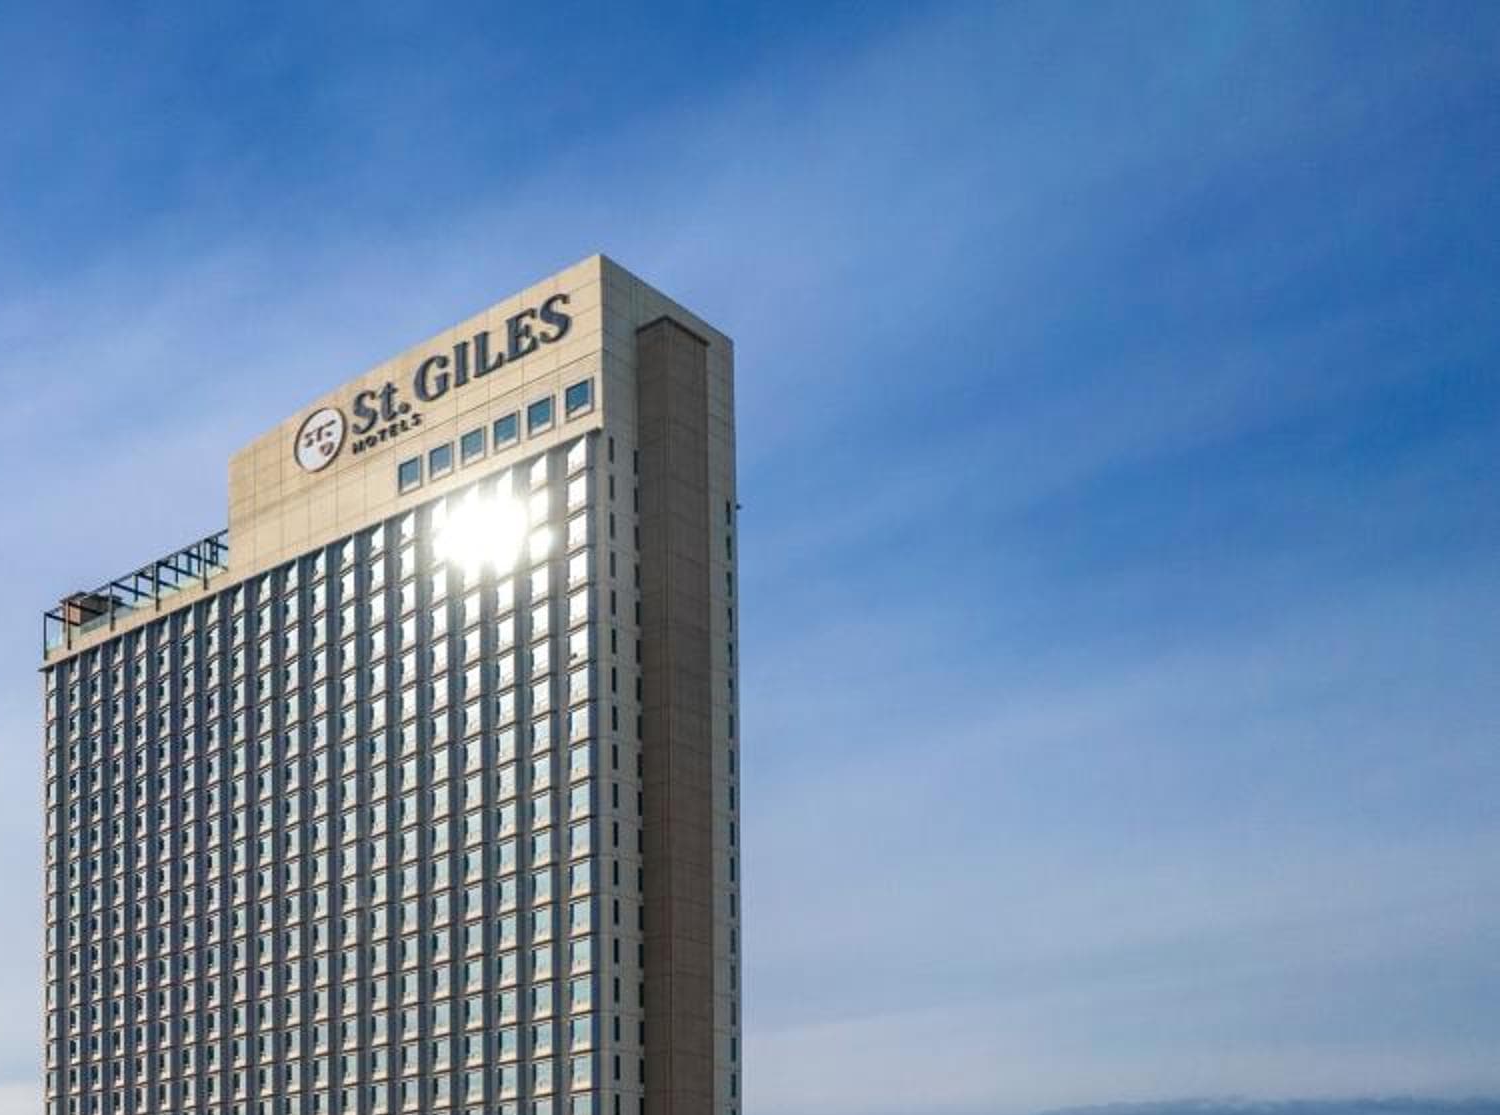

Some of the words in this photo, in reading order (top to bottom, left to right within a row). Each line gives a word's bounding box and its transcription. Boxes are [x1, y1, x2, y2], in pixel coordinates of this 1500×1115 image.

[352, 381, 411, 434] St.
[414, 293, 572, 403] GILES
[352, 412, 423, 455] HOTELS
